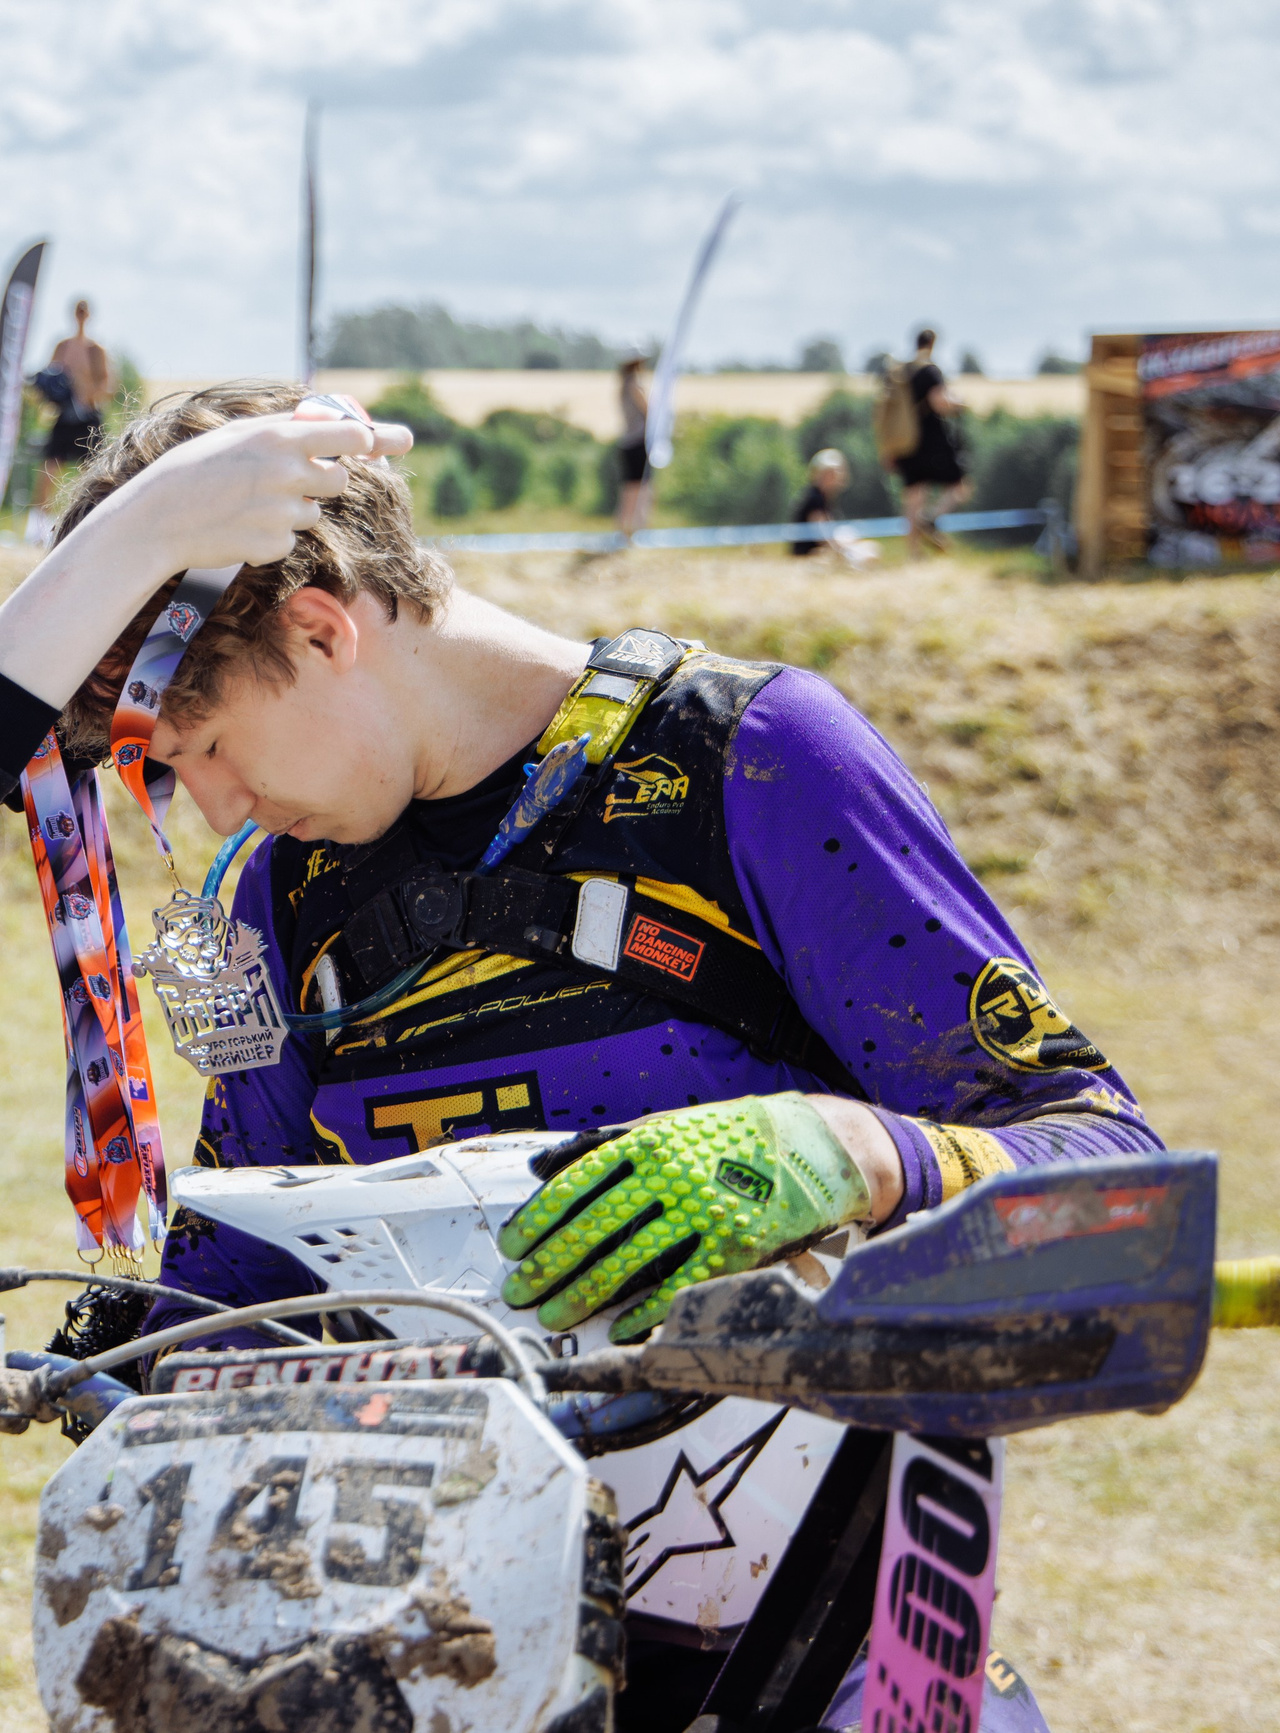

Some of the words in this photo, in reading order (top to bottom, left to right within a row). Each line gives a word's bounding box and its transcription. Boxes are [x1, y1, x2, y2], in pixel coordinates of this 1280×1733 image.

[634, 775, 689, 804] EPA
[646, 802, 671, 810] Enduro
[638, 922, 660, 937] NO
[630, 942, 691, 972] MONKEY
[634, 932, 696, 964] DANCING
[228, 1028, 274, 1047] ГОРЬКИЙ
[721, 1165, 767, 1202] 100%
[120, 1455, 437, 1592] 145
